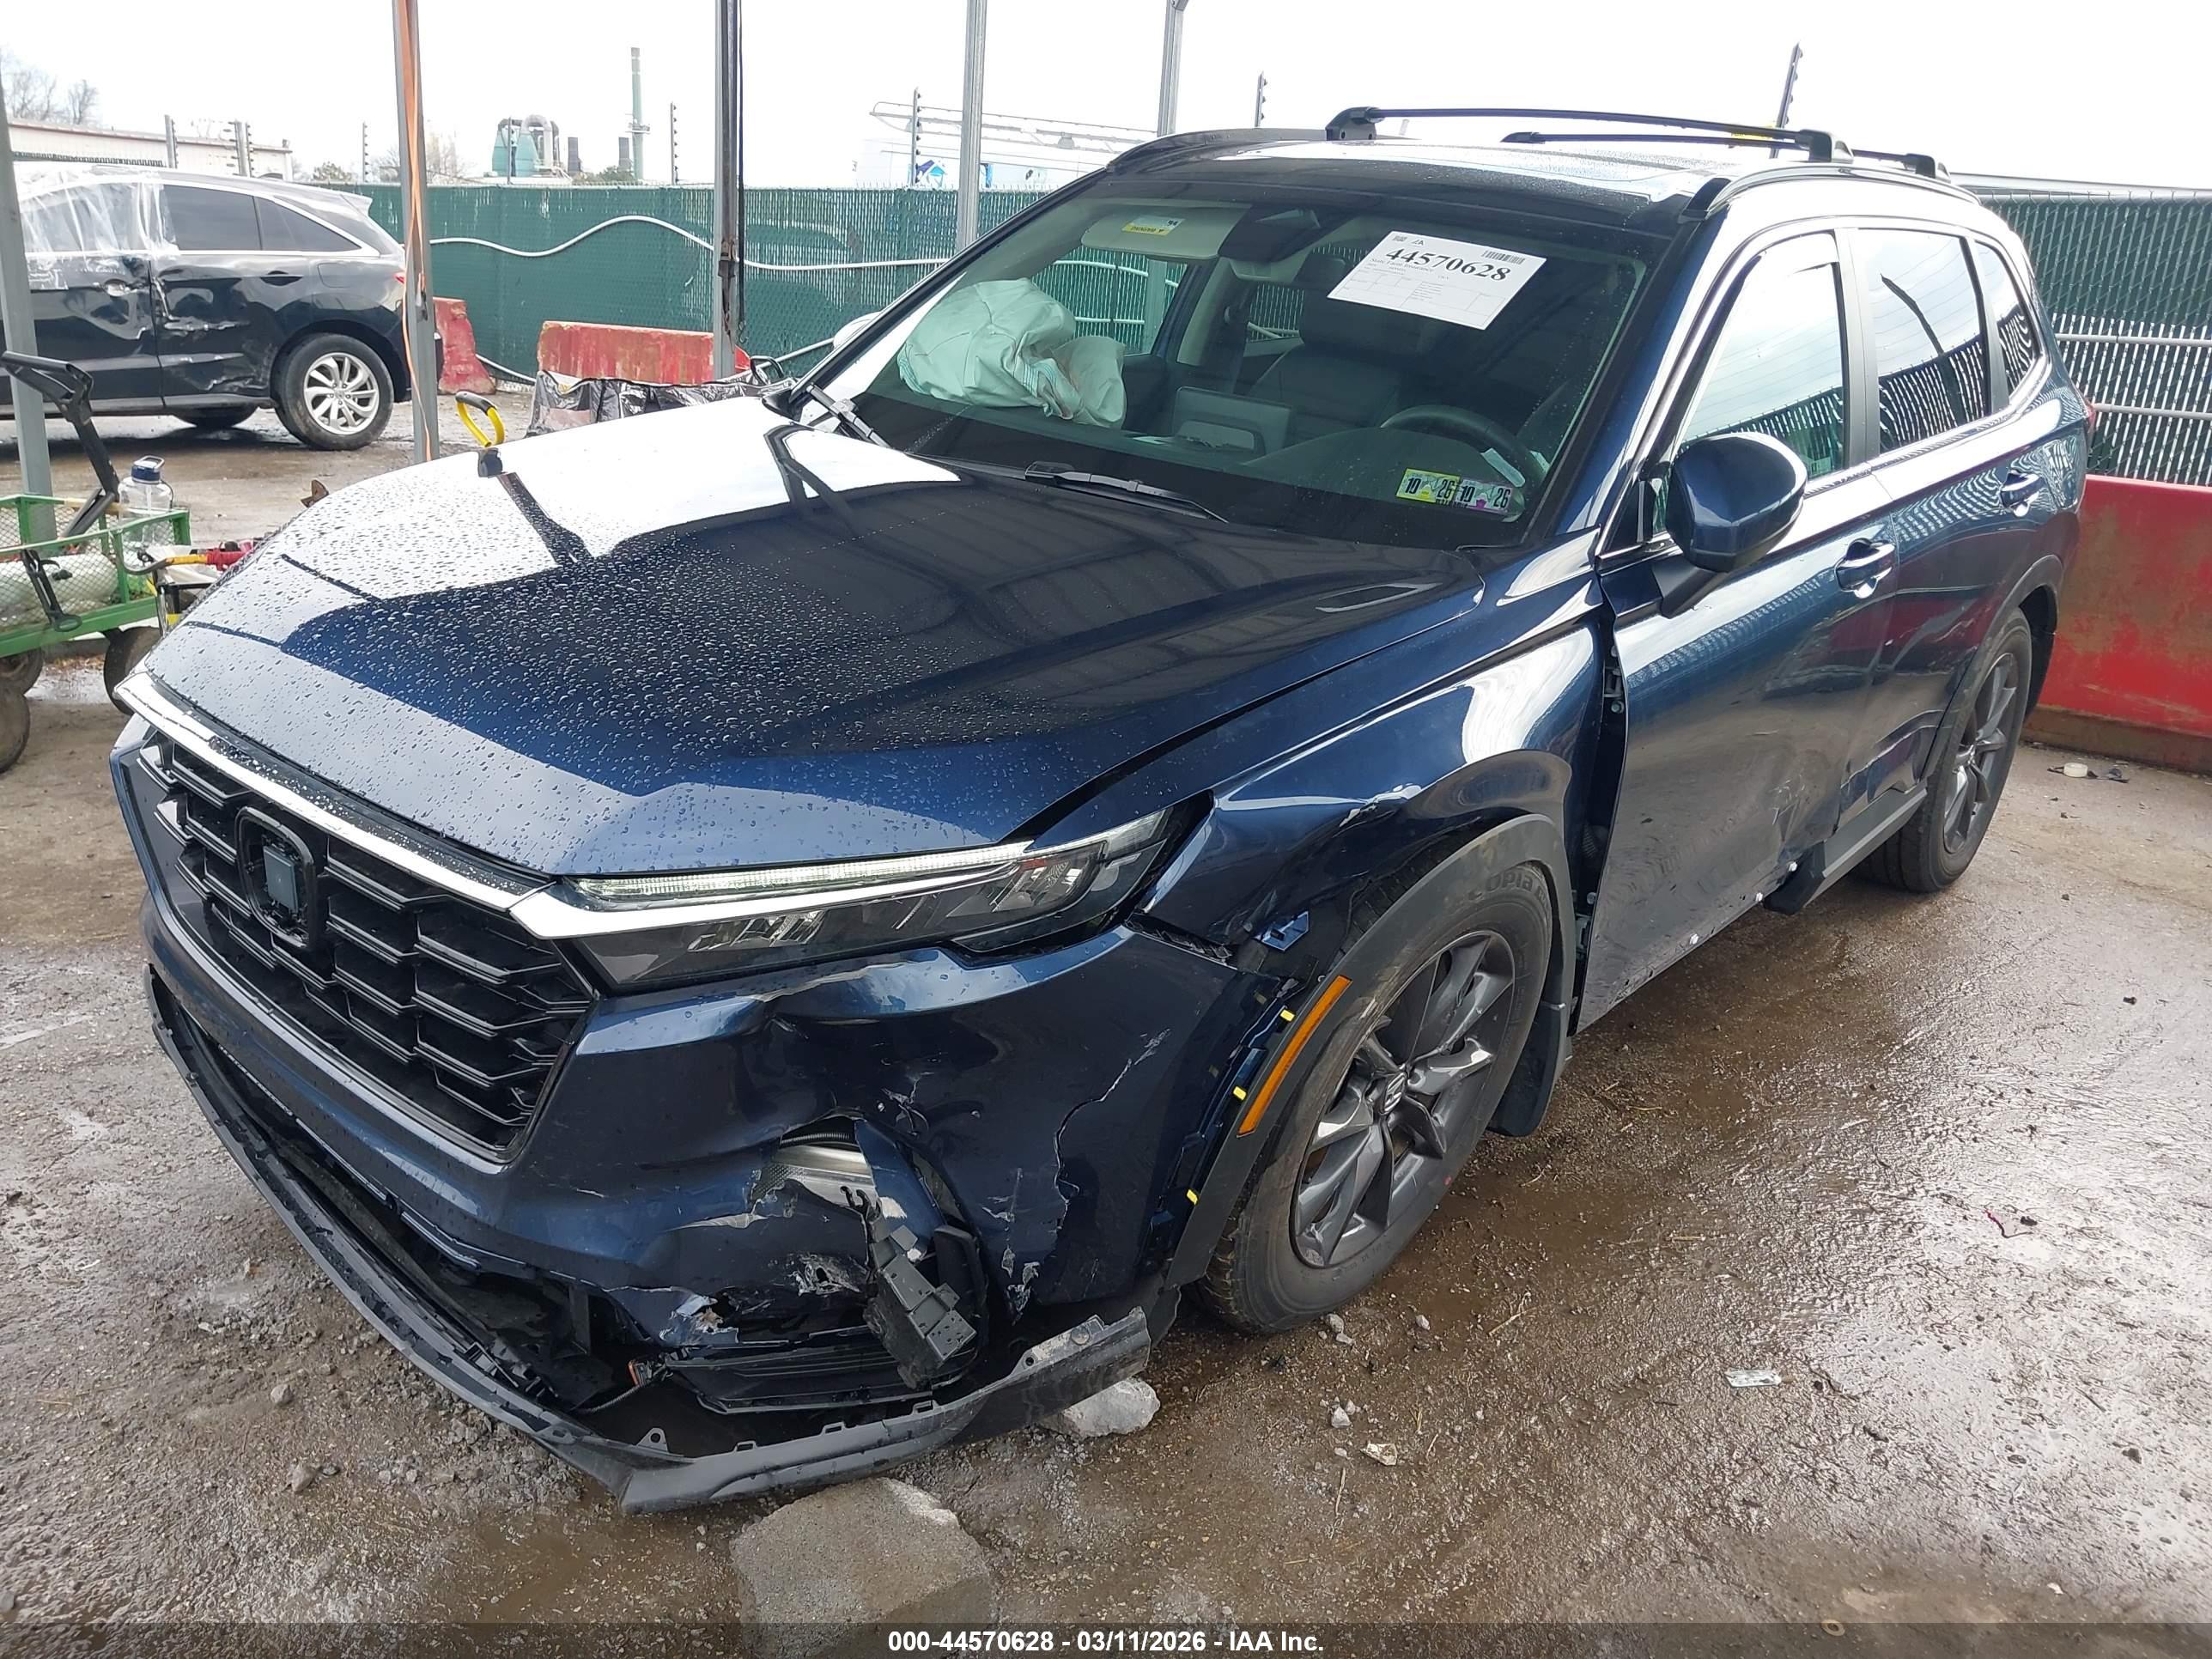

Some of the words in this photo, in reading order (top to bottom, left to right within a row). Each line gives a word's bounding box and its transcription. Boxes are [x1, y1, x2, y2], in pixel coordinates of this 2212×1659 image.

[1386, 248, 1511, 281] 44570628
[1437, 478, 1456, 499] 26
[1493, 487, 1511, 508] 26
